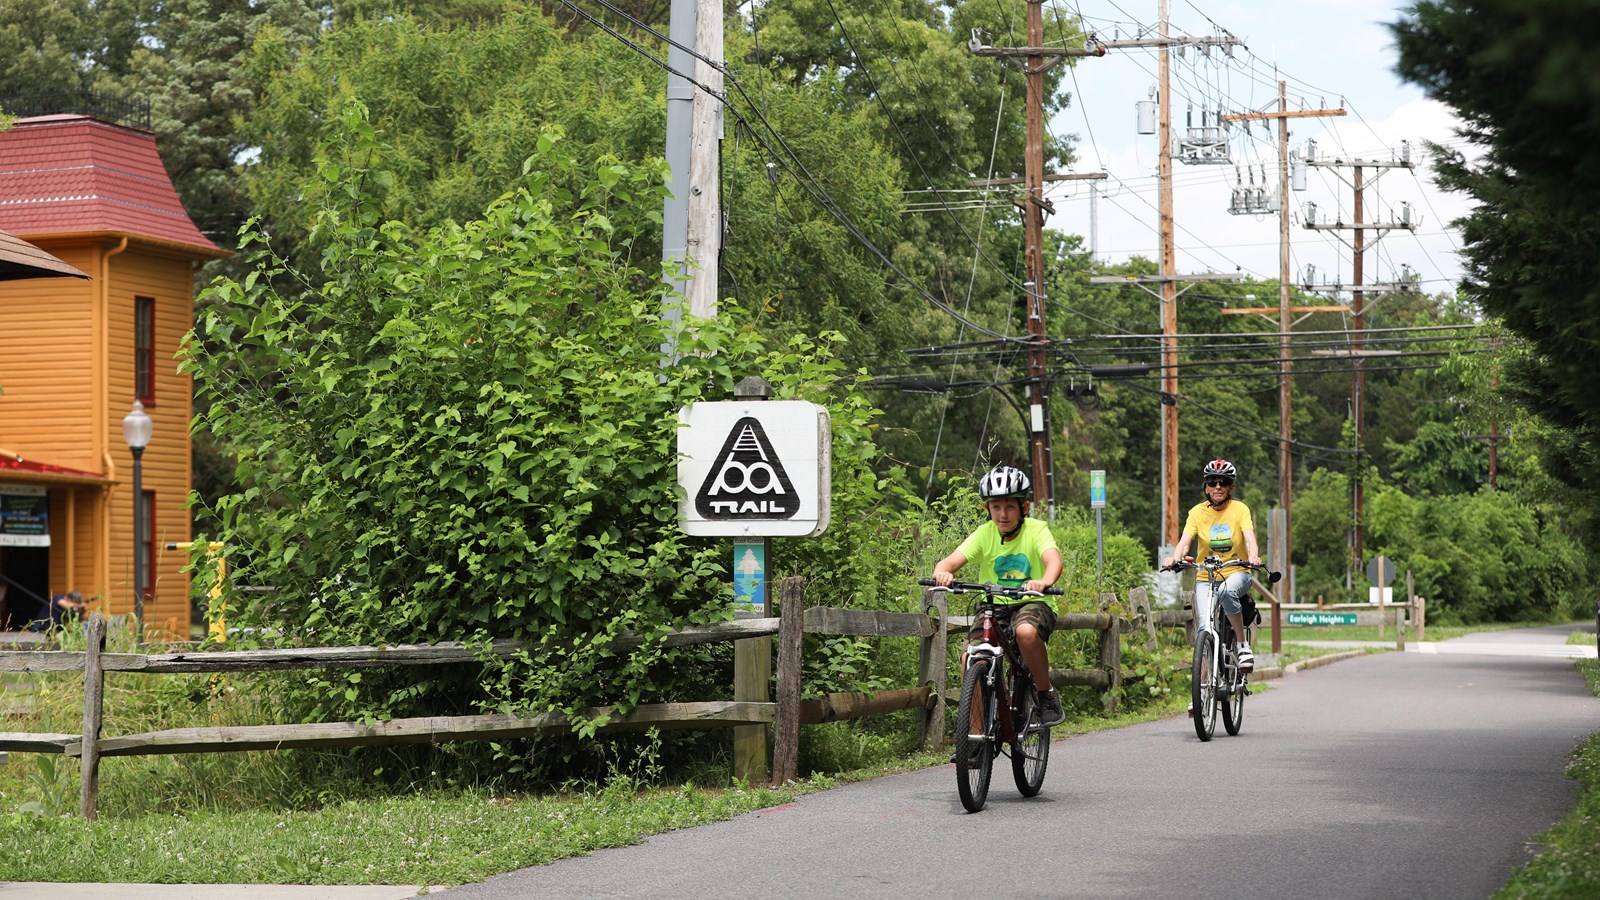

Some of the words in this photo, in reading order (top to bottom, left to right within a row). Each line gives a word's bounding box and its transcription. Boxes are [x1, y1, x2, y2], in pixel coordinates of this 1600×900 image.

[709, 501, 786, 514] TRAIL
[1289, 614, 1317, 625] Earleigh
[1319, 615, 1344, 625] Heights
